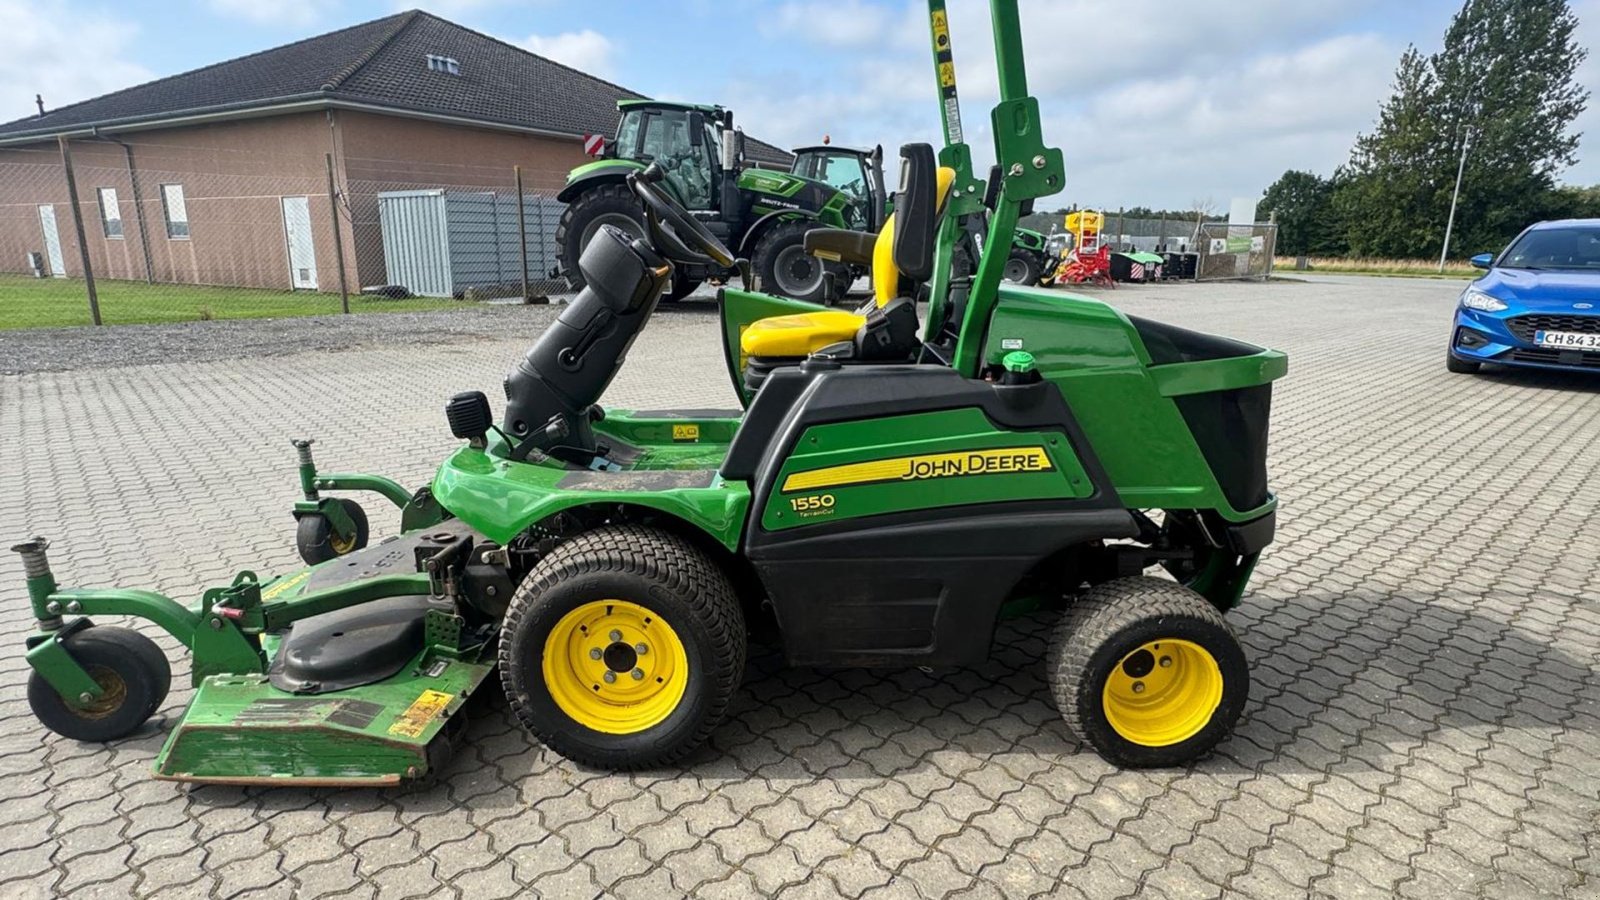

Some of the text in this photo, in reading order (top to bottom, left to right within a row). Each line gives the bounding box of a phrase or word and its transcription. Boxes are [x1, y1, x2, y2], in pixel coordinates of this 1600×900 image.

[1545, 333, 1564, 344] CH
[1566, 334, 1584, 345] 84
[902, 454, 1040, 478] JOHN DEERE
[790, 494, 835, 511] 1550
[799, 508, 835, 518] TerrainCut
